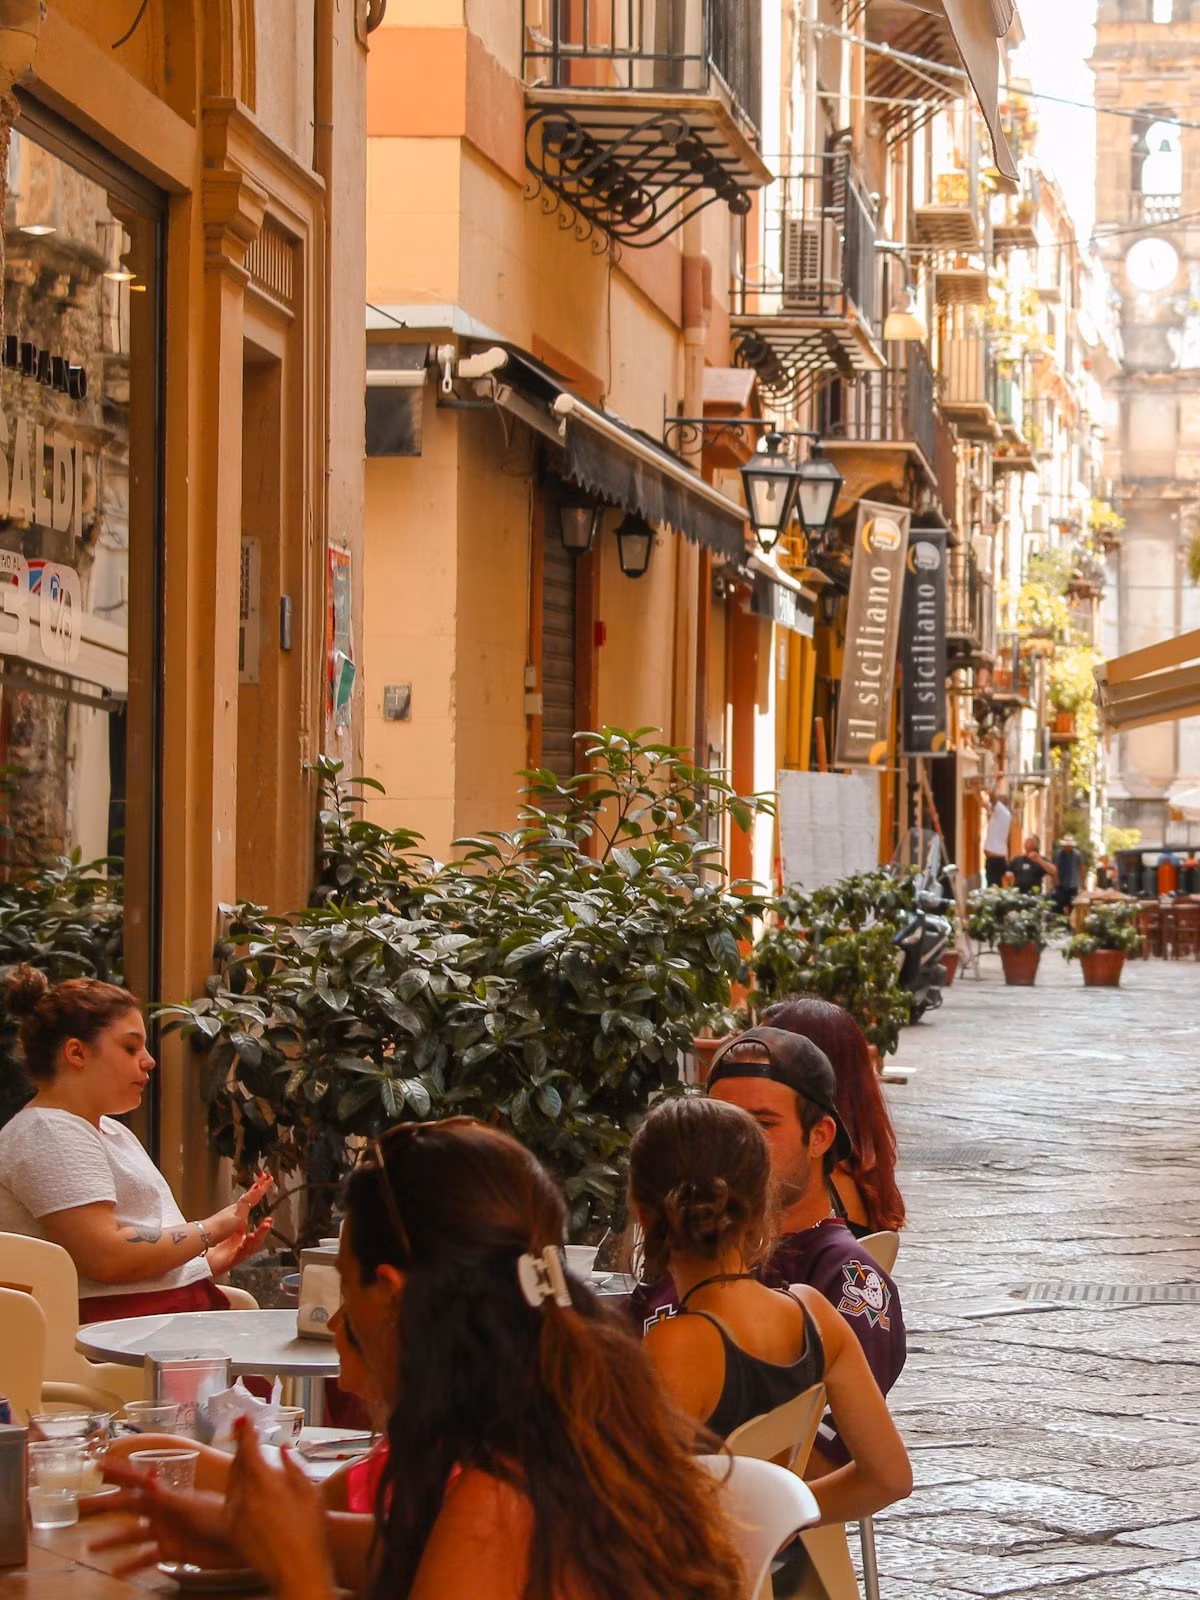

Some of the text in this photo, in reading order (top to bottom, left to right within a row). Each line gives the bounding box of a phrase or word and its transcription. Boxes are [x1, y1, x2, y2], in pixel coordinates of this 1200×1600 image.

[854, 566, 892, 706] siciliano
[911, 583, 937, 703] siciliano
[848, 718, 877, 740] il
[911, 714, 937, 732] il
